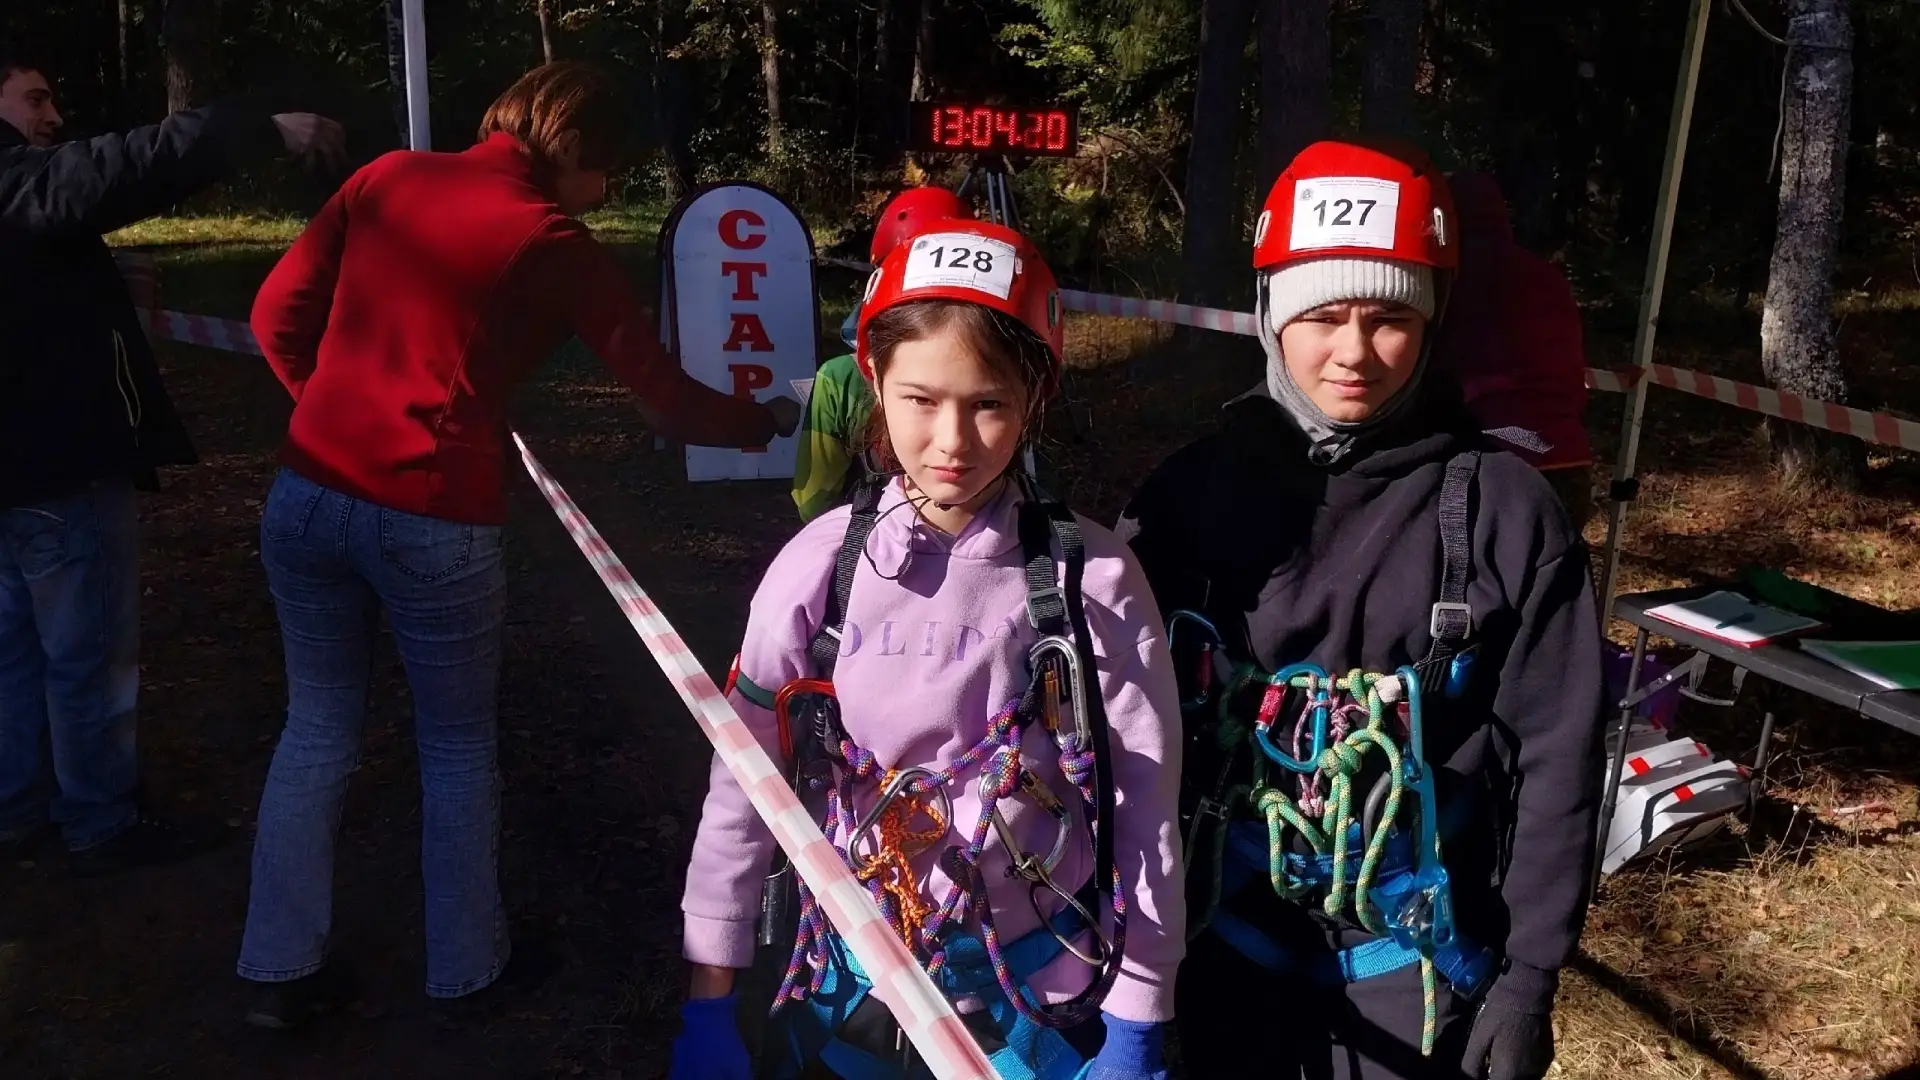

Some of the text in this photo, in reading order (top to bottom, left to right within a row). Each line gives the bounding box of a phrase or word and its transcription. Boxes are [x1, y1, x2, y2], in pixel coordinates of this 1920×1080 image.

[1313, 198, 1377, 227] 127
[929, 246, 993, 273] 128
[717, 209, 775, 453] СТАР
